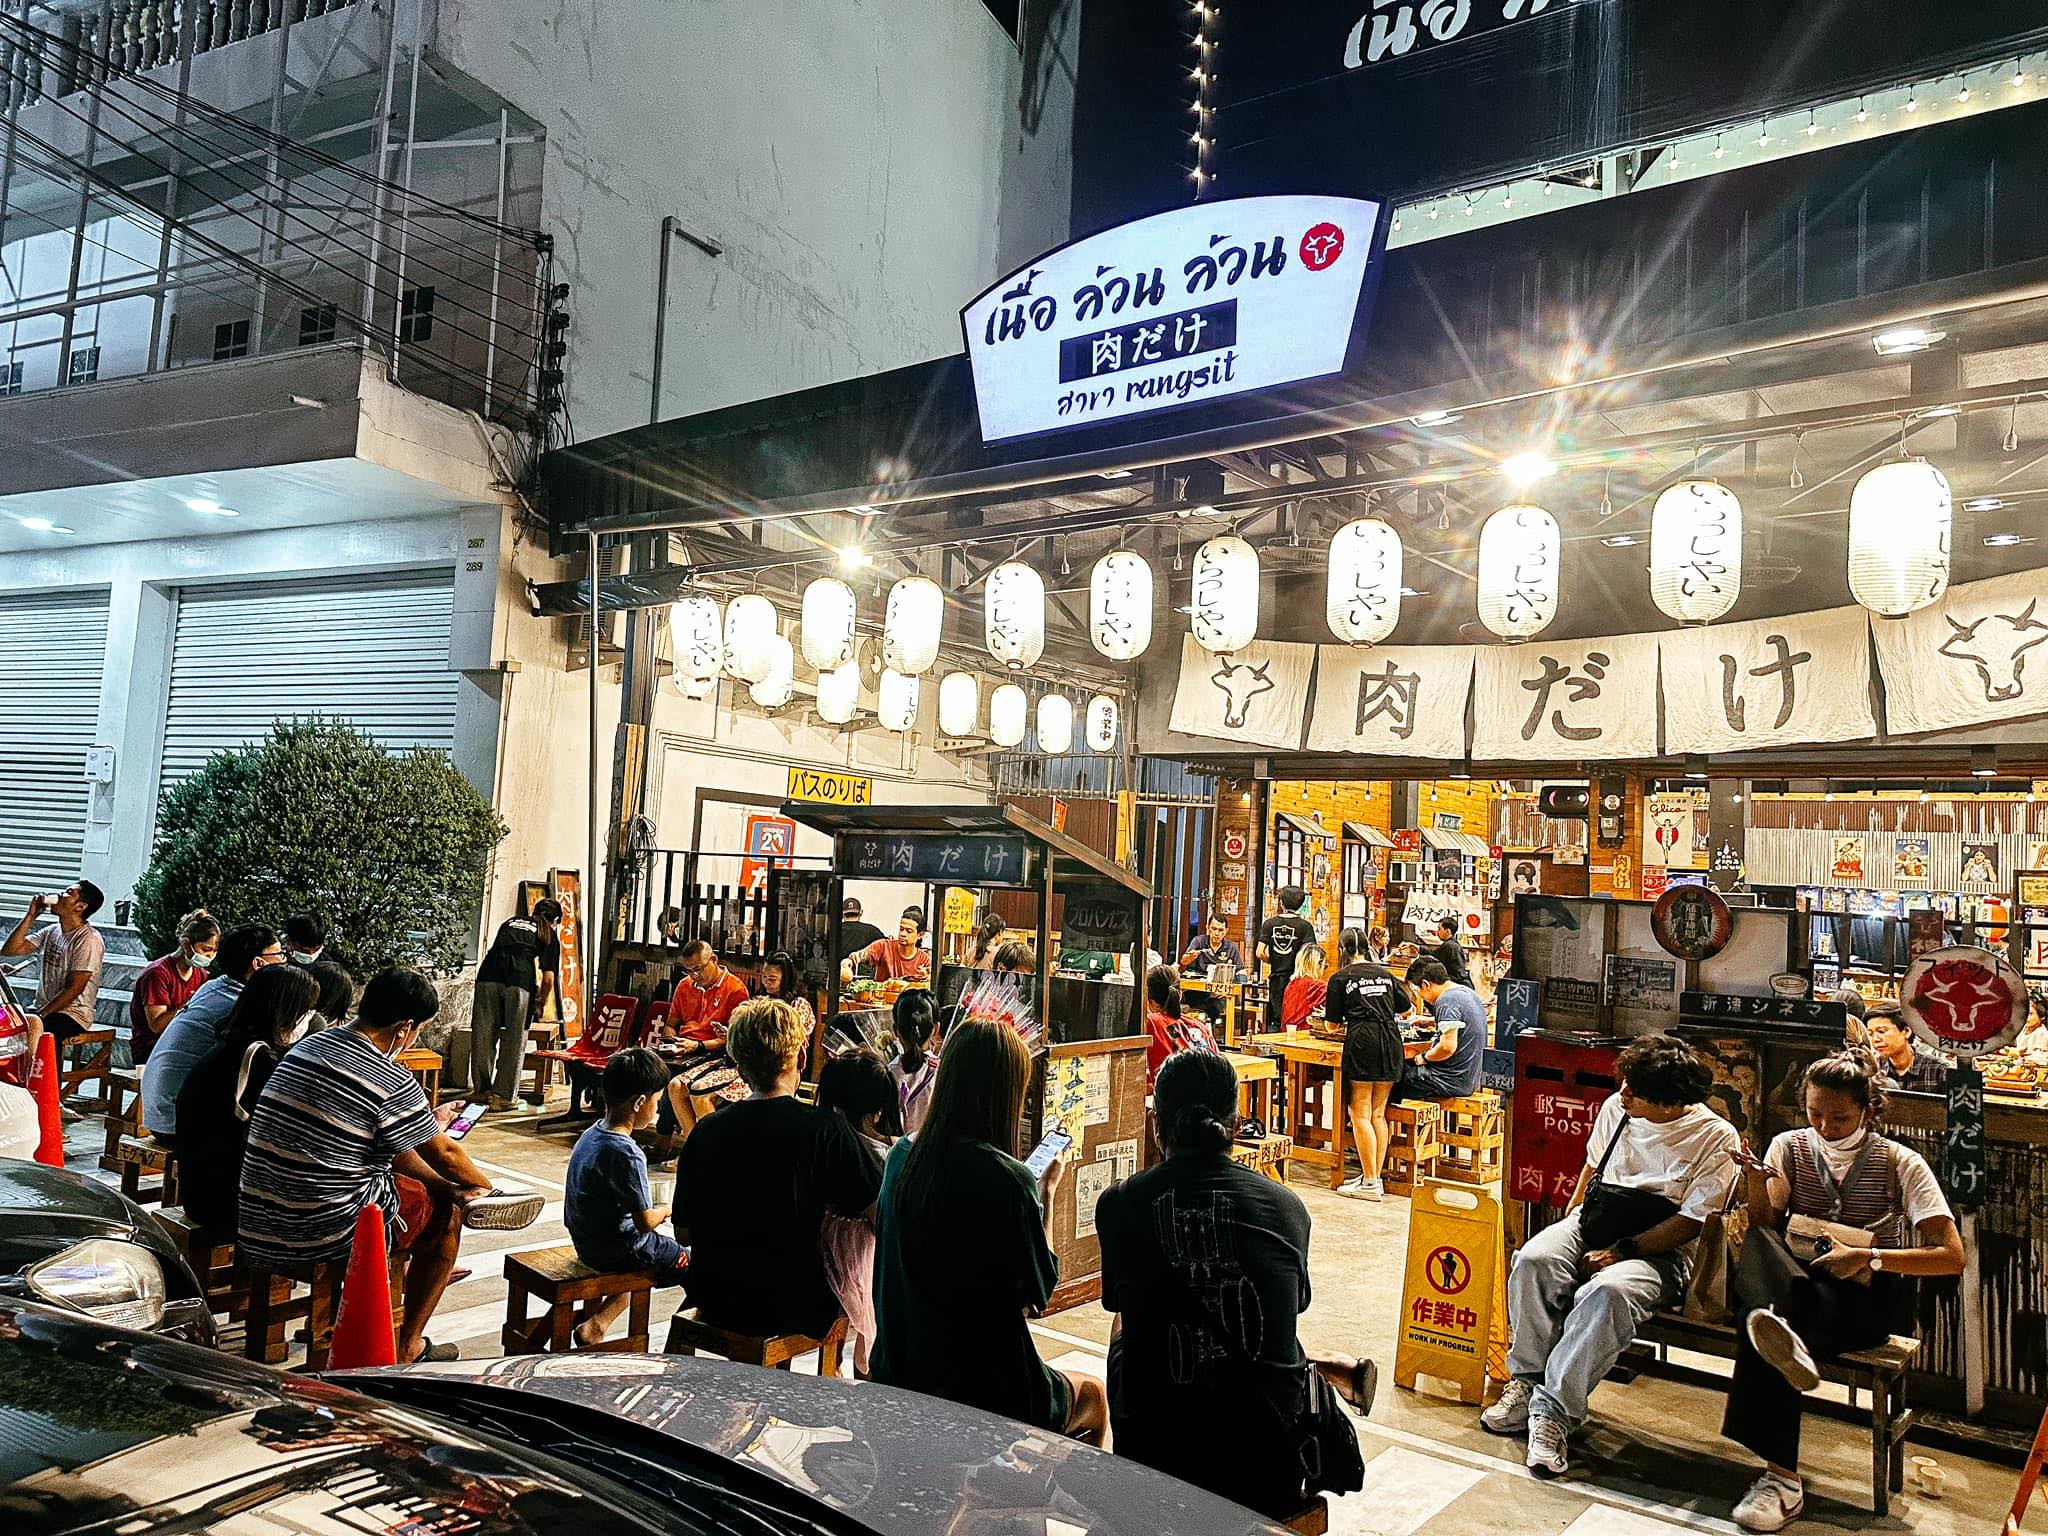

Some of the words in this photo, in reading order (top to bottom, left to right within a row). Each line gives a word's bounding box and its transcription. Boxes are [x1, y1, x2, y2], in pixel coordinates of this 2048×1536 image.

[984, 269, 1057, 346] เนื้อ
[1073, 265, 1164, 321] ล้วน
[1183, 234, 1286, 294] ล้วน
[1090, 312, 1208, 375] 肉だけ
[1057, 388, 1115, 416] สาขา
[1125, 350, 1240, 404] rangsit
[467, 539, 485, 549] 287
[1356, 634, 1812, 741] 肉だけ
[791, 771, 867, 803] バスのりば
[1649, 803, 1687, 816] Glico
[891, 840, 1009, 877] 肉だけ
[1489, 859, 1500, 898] 肉だけ
[1938, 1035, 1988, 1051] 肉だけ
[1948, 1083, 1985, 1195] 肉だけ
[1412, 1296, 1477, 1333] 作業中
[1409, 1332, 1429, 1343] WORK
[1430, 1337, 1437, 1345] IN
[1438, 1339, 1475, 1354] PROGRESS
